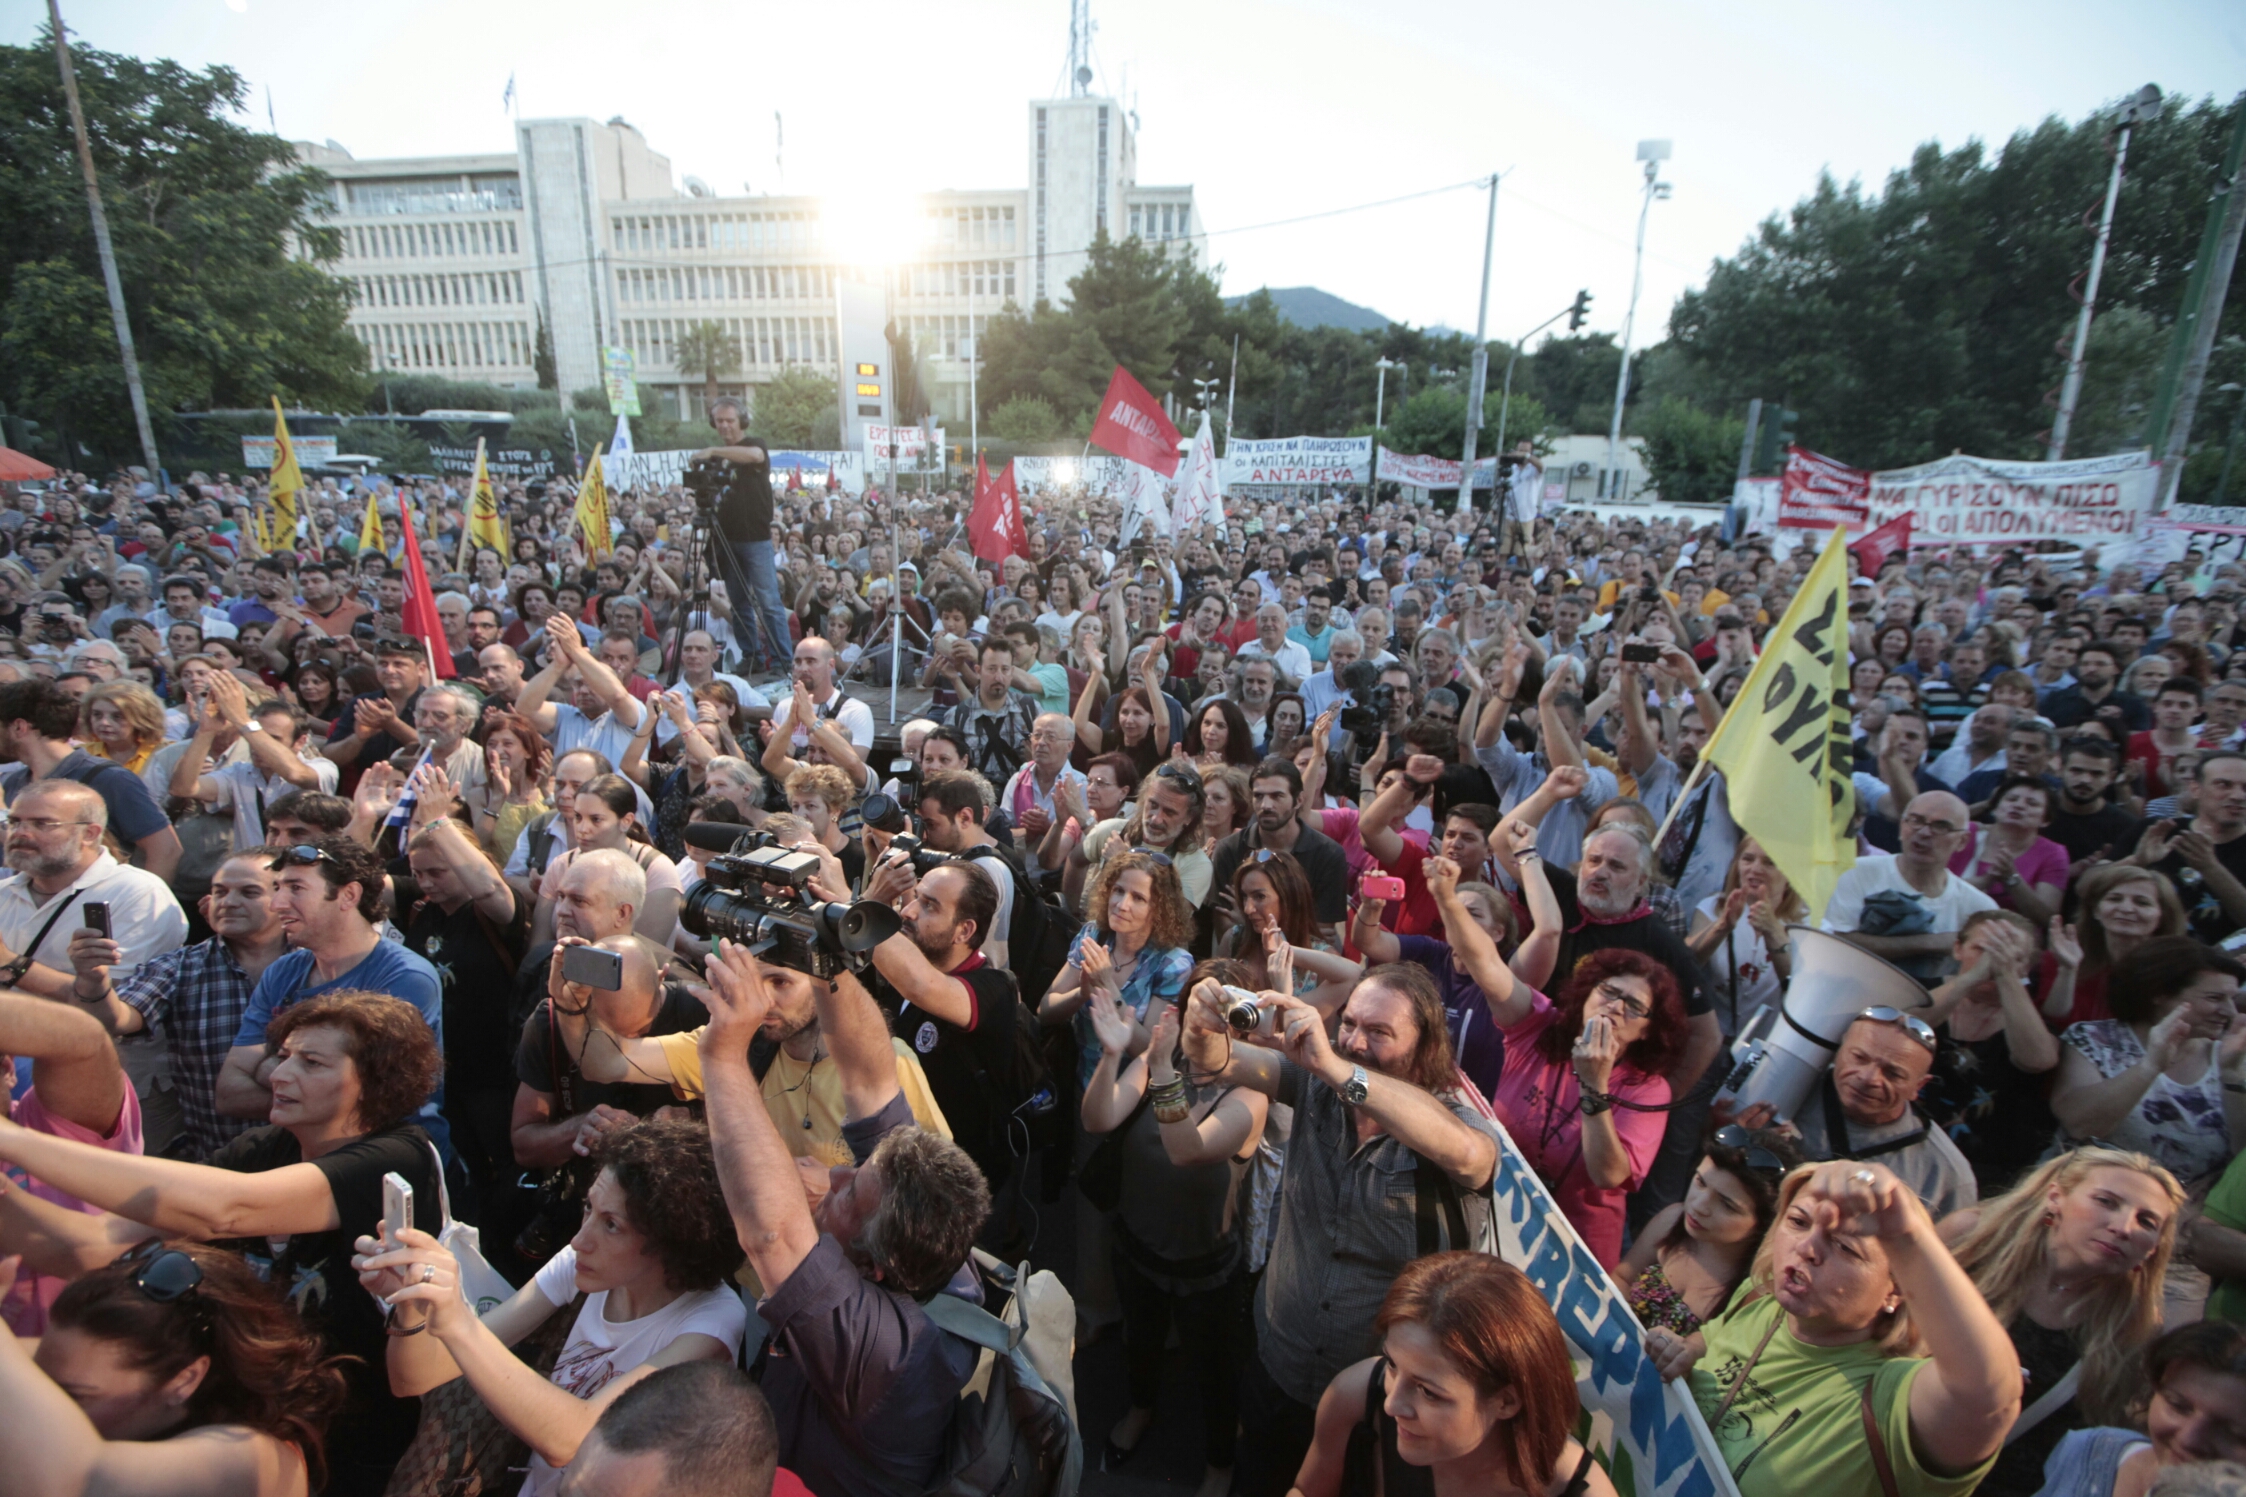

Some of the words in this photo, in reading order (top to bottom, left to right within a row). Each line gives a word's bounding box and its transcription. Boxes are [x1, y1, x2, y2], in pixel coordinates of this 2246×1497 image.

[869, 425, 914, 443] ΕΡΓΤΕΣ
[1231, 441, 1252, 453] ΤΗΝ
[1256, 441, 1285, 453] ΚΡΙΣΗ
[1286, 440, 1299, 452] ΝΑ
[1302, 439, 1367, 453] ΠΛΗΡΩΣΟΥΝ
[1251, 468, 1355, 482] ΑΝΤΑΡΣΥΑ
[1915, 483, 2046, 508] ΓΥΡΙΣΟΥΝ
[2053, 482, 2120, 508] ΠΙΣΩ
[1964, 509, 2136, 535] ΑΠΟΛΥΜΕΝΟΙ
